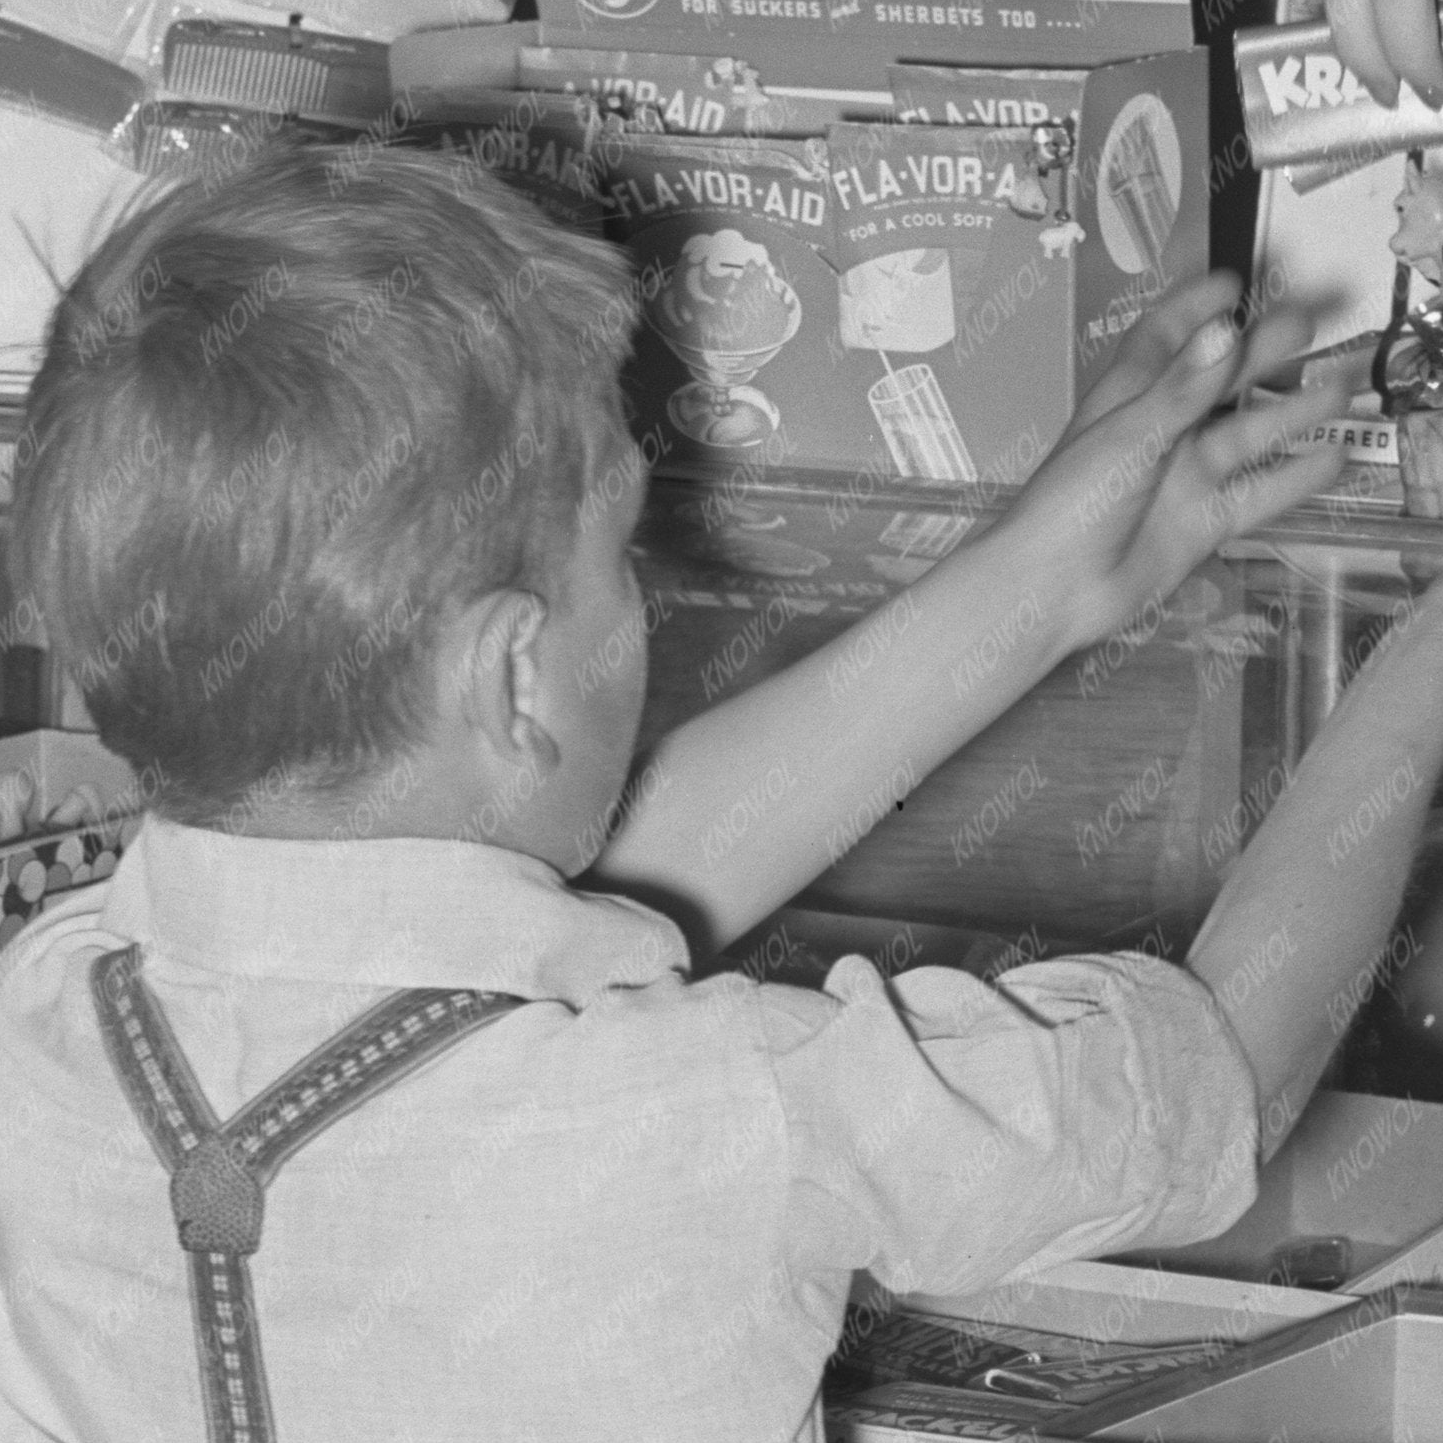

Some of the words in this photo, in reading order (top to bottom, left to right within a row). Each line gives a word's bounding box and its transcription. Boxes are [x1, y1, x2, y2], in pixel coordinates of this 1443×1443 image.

[875, 3, 985, 28] SHERBETS
[998, 8, 1037, 29] TOO
[884, 219, 897, 231] A
[902, 212, 946, 231] COOL
[952, 213, 995, 231] SOFT
